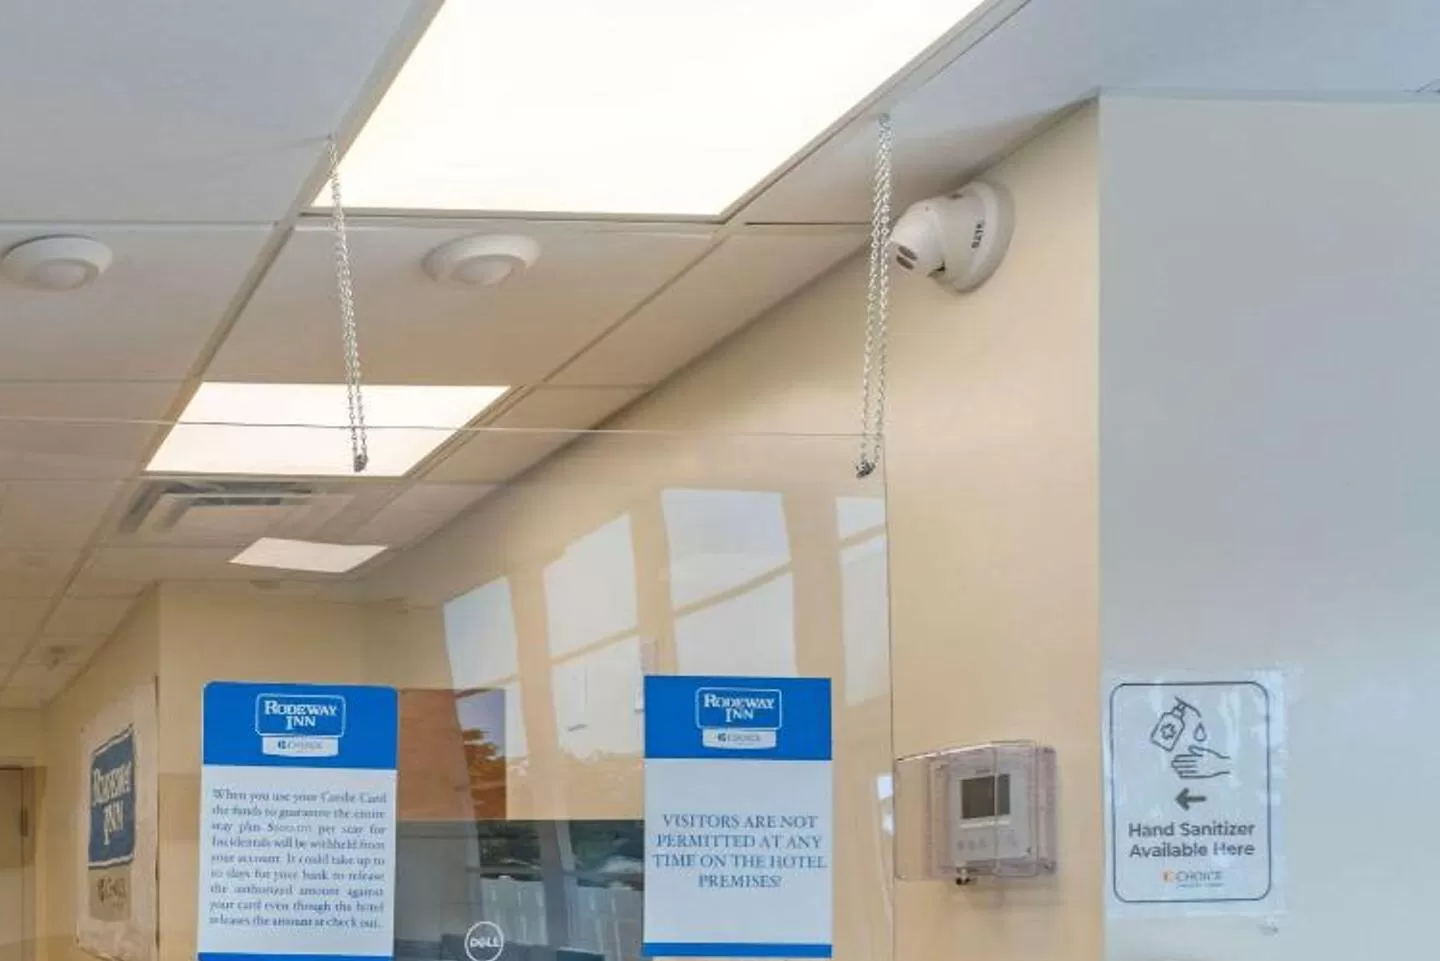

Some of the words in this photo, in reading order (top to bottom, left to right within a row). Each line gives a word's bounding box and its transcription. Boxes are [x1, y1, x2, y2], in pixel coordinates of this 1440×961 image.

[264, 700, 337, 716] RODEWAY
[703, 693, 776, 709] RODEWAY
[285, 715, 317, 730] INN
[725, 708, 754, 723] INN
[212, 788, 246, 800] When
[249, 792, 269, 804] you
[272, 791, 290, 801] use
[292, 793, 317, 804] your
[334, 808, 350, 818] the
[104, 799, 124, 846] INN
[662, 814, 740, 829] VISITORS
[744, 815, 777, 829] ARE
[780, 815, 819, 830] NOT
[1128, 822, 1175, 837] Hand
[1179, 821, 1256, 837] Sanitizer
[295, 837, 306, 849] be
[656, 834, 755, 849] PERMITTED
[761, 835, 783, 849] AT
[787, 835, 823, 850] ANY
[1129, 841, 1209, 858] Available
[1213, 841, 1256, 856] Here
[331, 854, 354, 866] take
[356, 857, 371, 869] up
[373, 856, 385, 866] to
[652, 854, 697, 868] TIME
[700, 854, 726, 869] ON
[730, 854, 765, 869] THE
[768, 855, 828, 870] HOTEL
[1175, 870, 1224, 882] CHOICE
[264, 902, 290, 911] even
[292, 900, 332, 915] though
[469, 937, 501, 949] DELL
